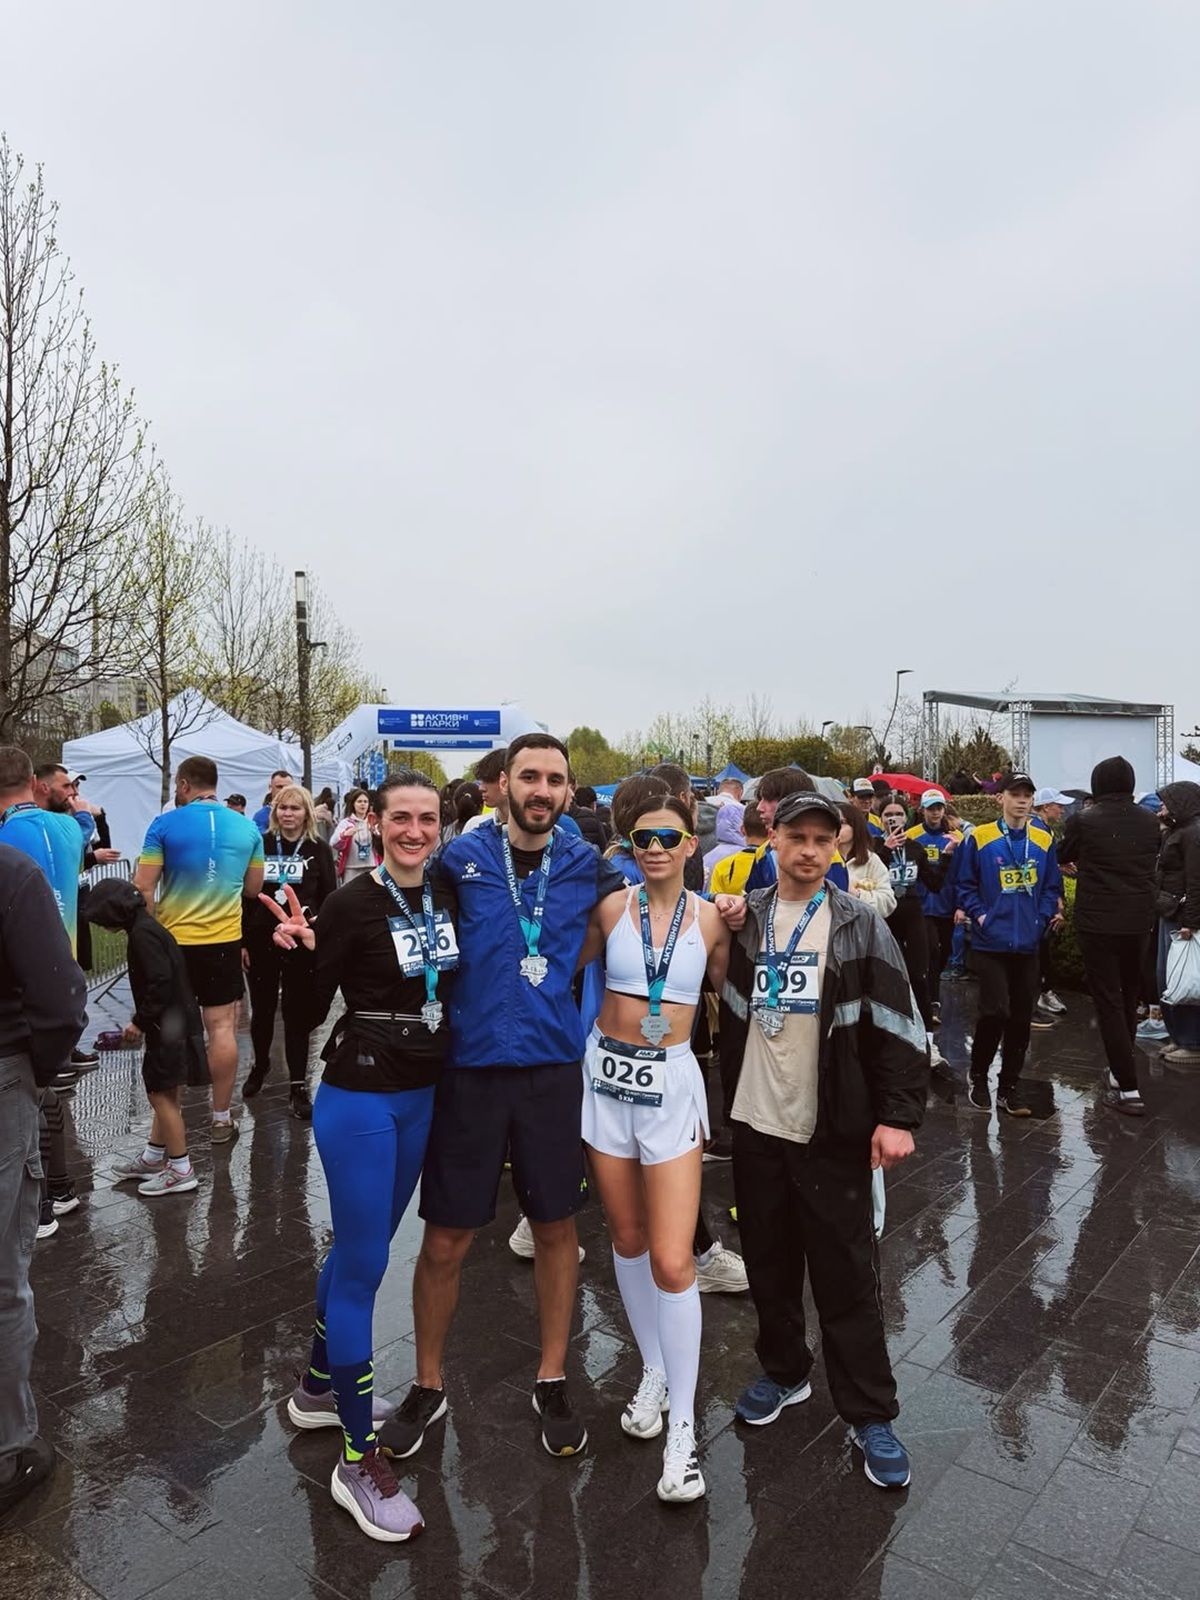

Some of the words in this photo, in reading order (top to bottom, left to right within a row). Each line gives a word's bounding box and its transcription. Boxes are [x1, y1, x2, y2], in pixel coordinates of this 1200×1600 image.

[425, 713, 468, 721] АКТИВНІ
[503, 838, 514, 873] АКТИВНІ
[892, 868, 914, 879] 12
[1004, 872, 1032, 884] 824
[508, 874, 521, 906] ПАРКИ
[402, 928, 450, 957] 26
[662, 926, 679, 965] АКТИВНІ
[672, 897, 686, 926] ПАРКИ
[602, 1056, 653, 1087] 026
